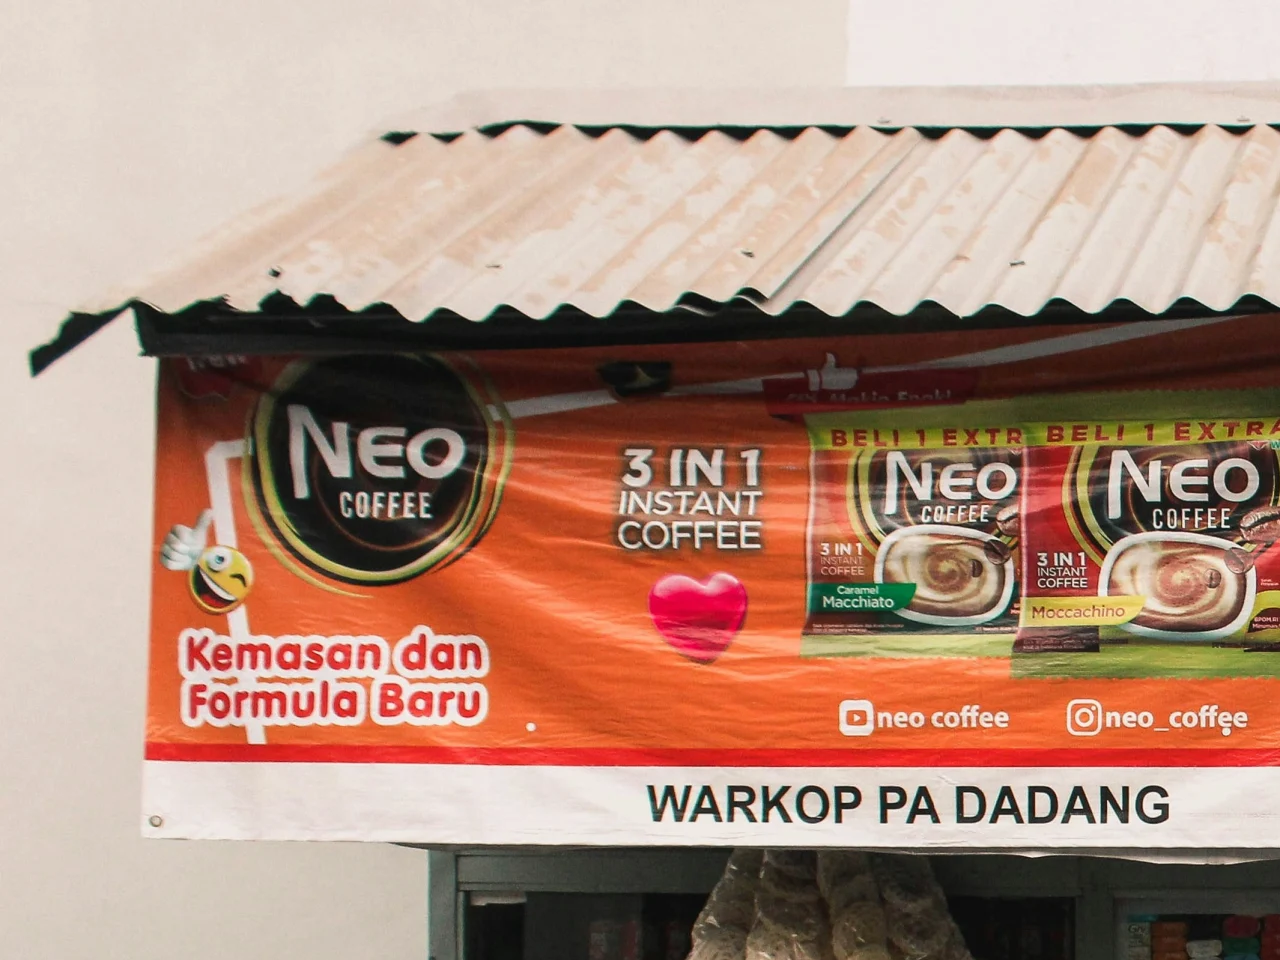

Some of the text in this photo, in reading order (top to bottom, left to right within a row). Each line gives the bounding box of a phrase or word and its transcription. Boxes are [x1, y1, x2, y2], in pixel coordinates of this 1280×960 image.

[831, 429, 899, 447] BELI
[916, 430, 925, 447] 1
[1046, 424, 1125, 442] BELI
[1144, 424, 1155, 441] 1
[287, 404, 466, 499] NEO
[622, 449, 760, 487] 3 IN 1
[884, 451, 1017, 515] NEO
[1107, 449, 1260, 520] NEO
[339, 491, 433, 519] COFFEE
[619, 491, 763, 515] INSTANT
[921, 505, 990, 523] COFFEE
[1152, 508, 1231, 529] COFFEE
[618, 521, 762, 549] COFFEE
[820, 543, 862, 556] 3 IN 1
[1037, 552, 1086, 566] 3 IN 1
[820, 557, 863, 565] INSTANT
[820, 567, 865, 576] COFFEE
[1037, 567, 1087, 577] INSTANT
[1037, 577, 1088, 588] COFFEE
[837, 585, 879, 595] Caramel
[822, 596, 895, 609] Macchiato
[1032, 605, 1126, 619] Moccachino
[187, 634, 482, 671] Kemasan dan
[190, 680, 480, 719] Formula Baru
[877, 703, 1009, 728] neo coffee
[1105, 703, 1248, 731] neo_coffee
[648, 785, 1170, 824] WARKOP PA DADANG
